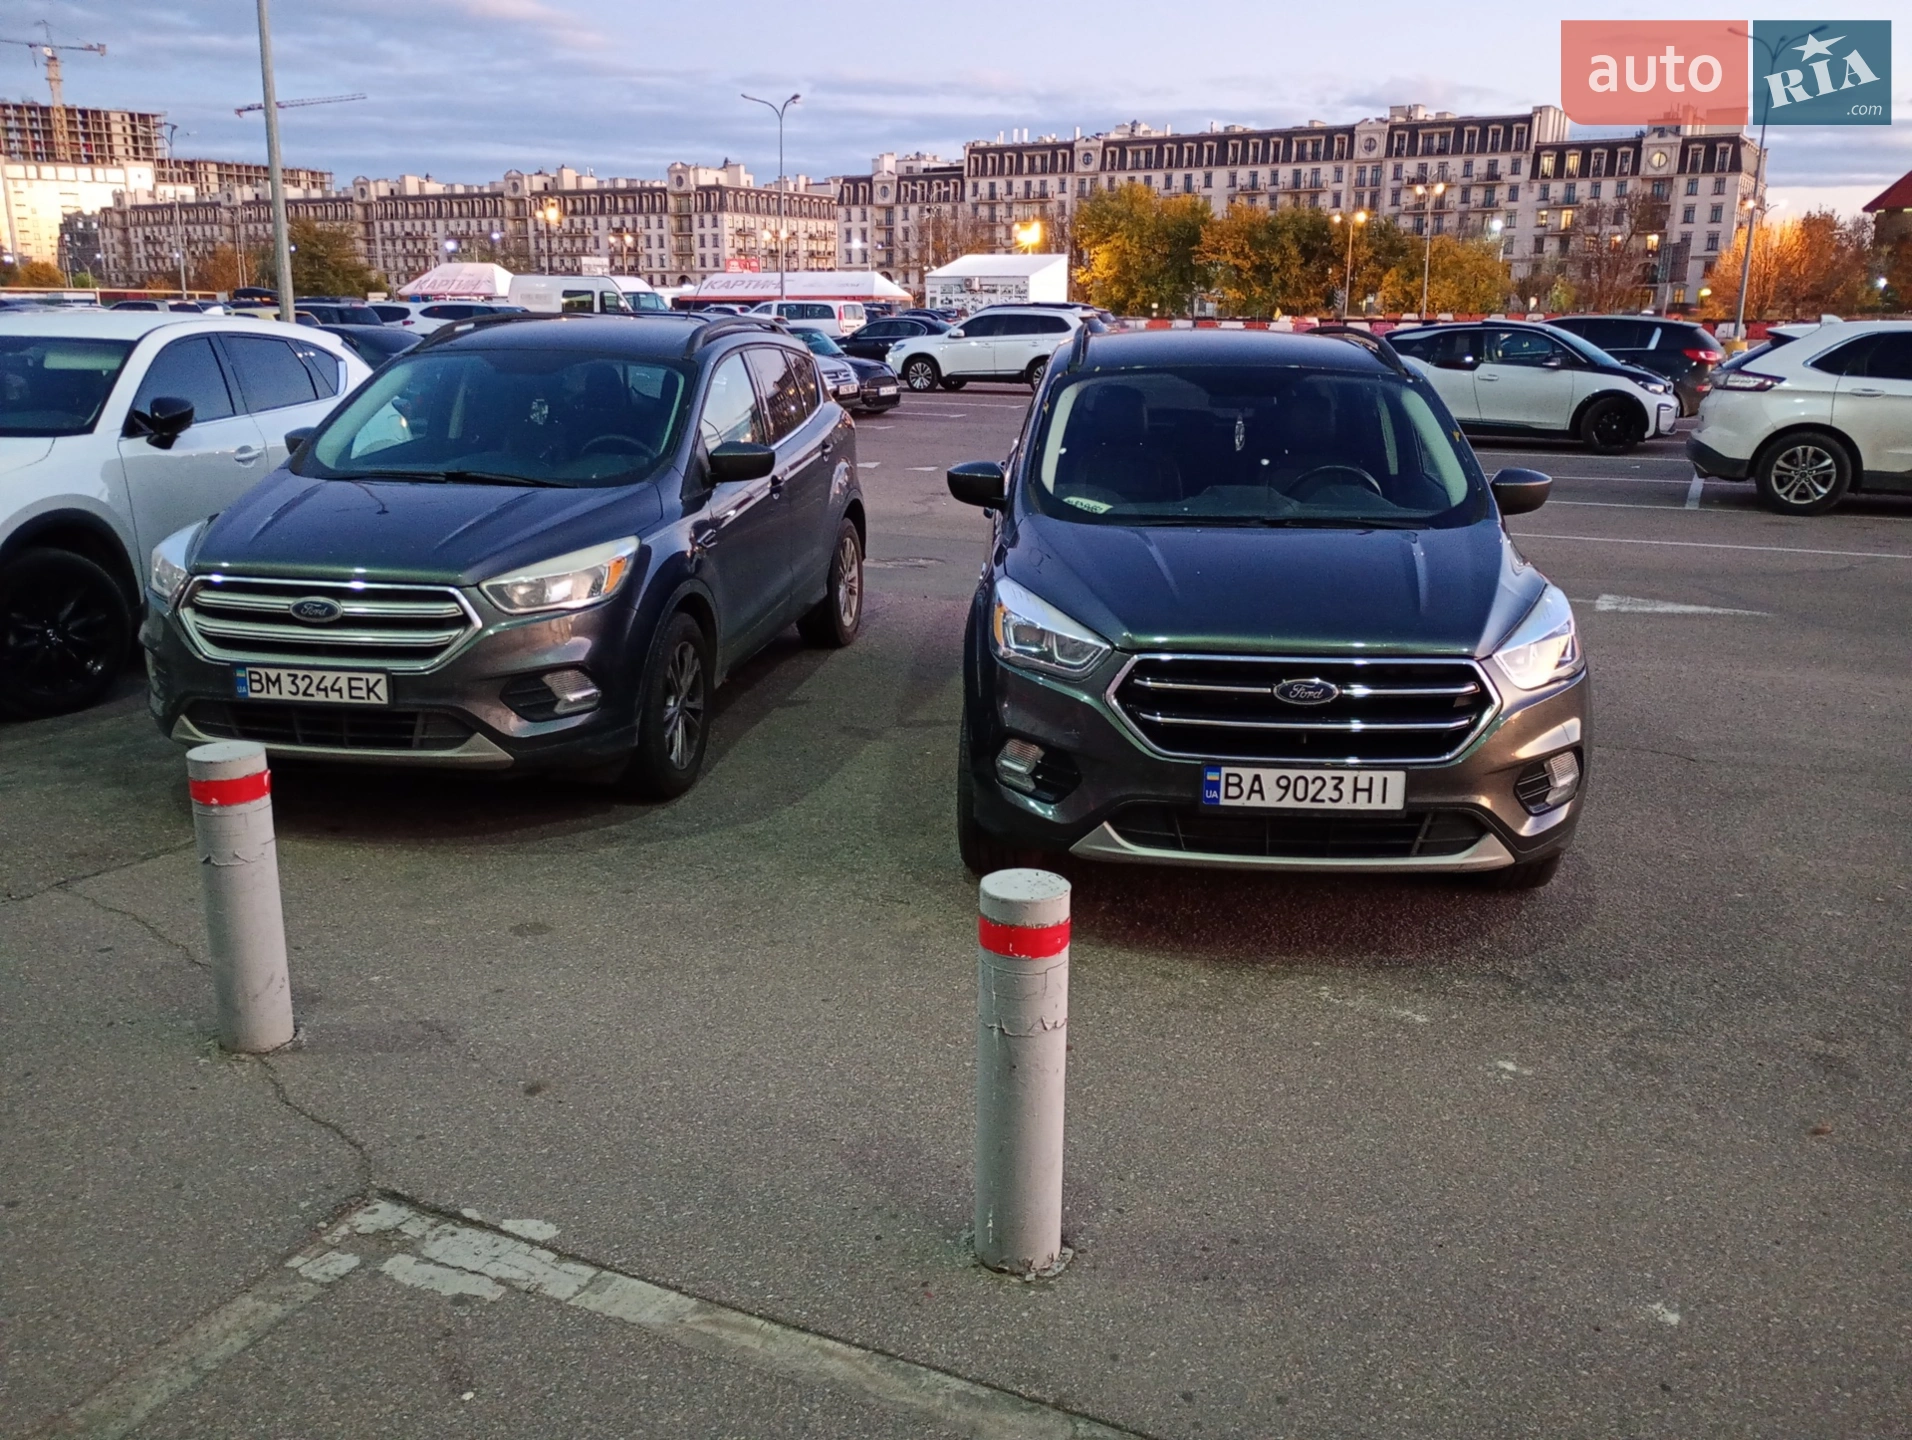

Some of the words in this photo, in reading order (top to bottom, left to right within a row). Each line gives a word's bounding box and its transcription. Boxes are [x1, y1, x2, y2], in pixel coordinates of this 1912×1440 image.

[300, 602, 329, 617] Ford
[237, 685, 247, 693] UA
[1289, 683, 1324, 699] Ford
[1205, 789, 1219, 799] UA
